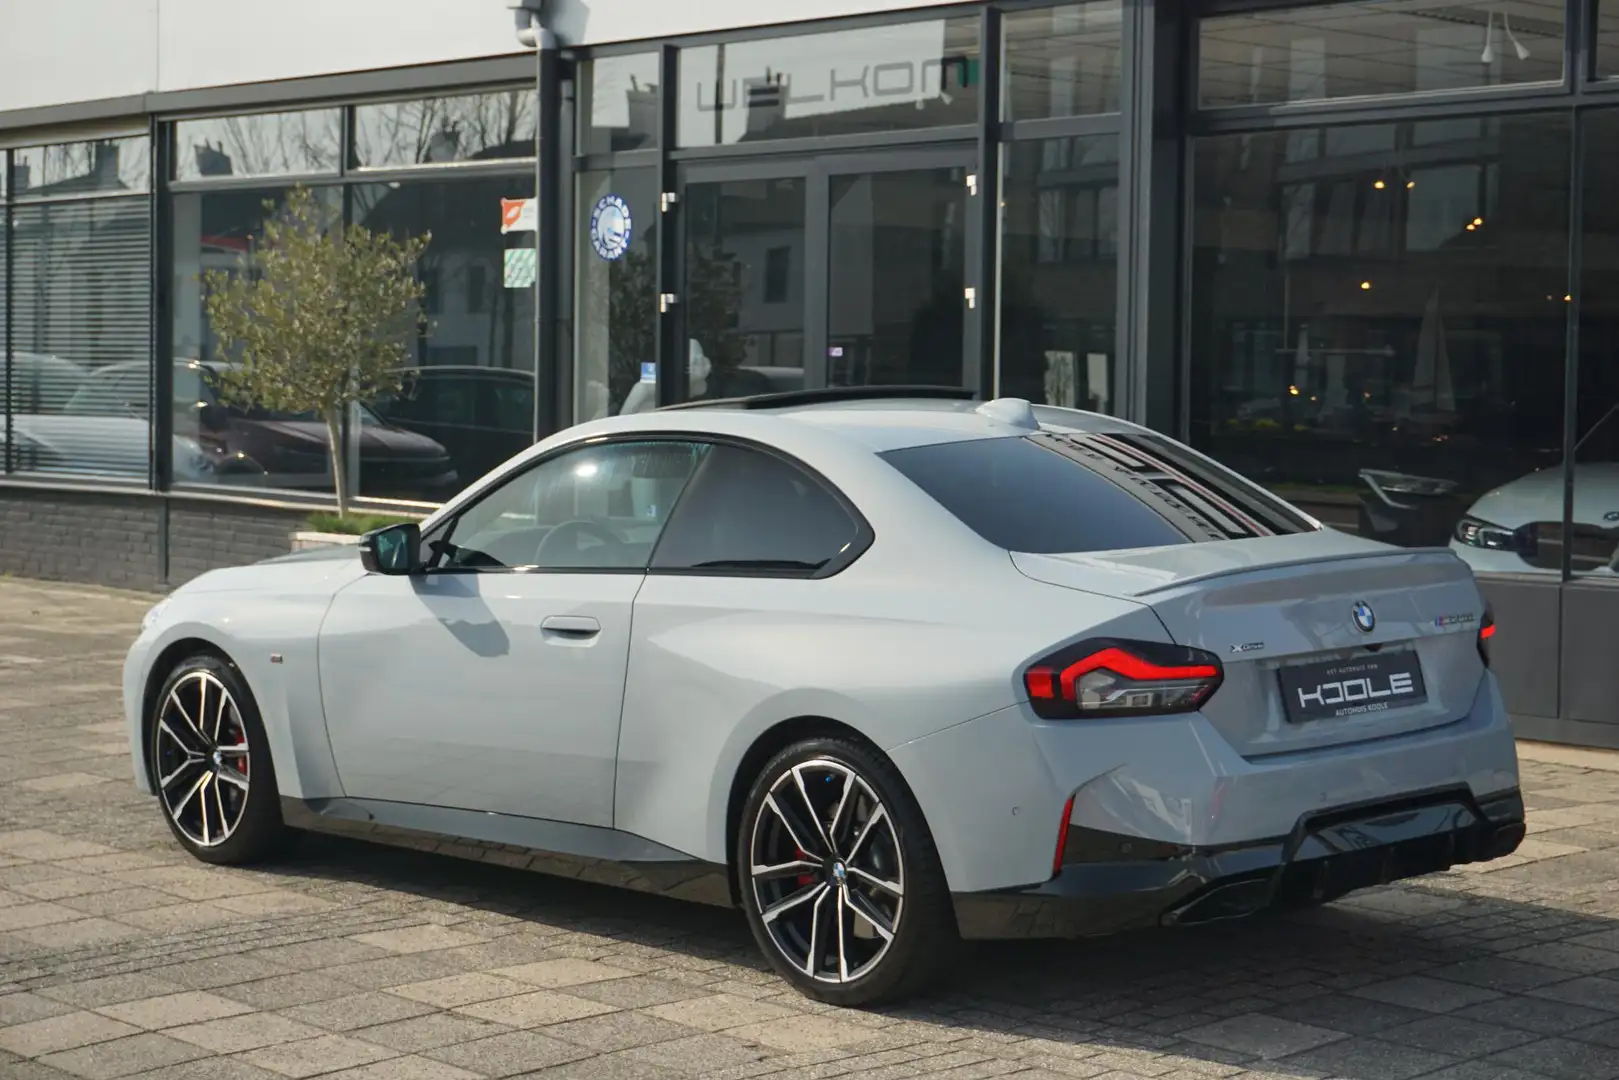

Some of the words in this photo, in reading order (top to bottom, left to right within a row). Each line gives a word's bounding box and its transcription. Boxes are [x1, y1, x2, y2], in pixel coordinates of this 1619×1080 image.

[696, 55, 969, 111] WELKOM
[1297, 672, 1414, 708] KOOLE
[1335, 704, 1367, 716] AUTOHUIS
[1367, 701, 1389, 711] KOOLE
